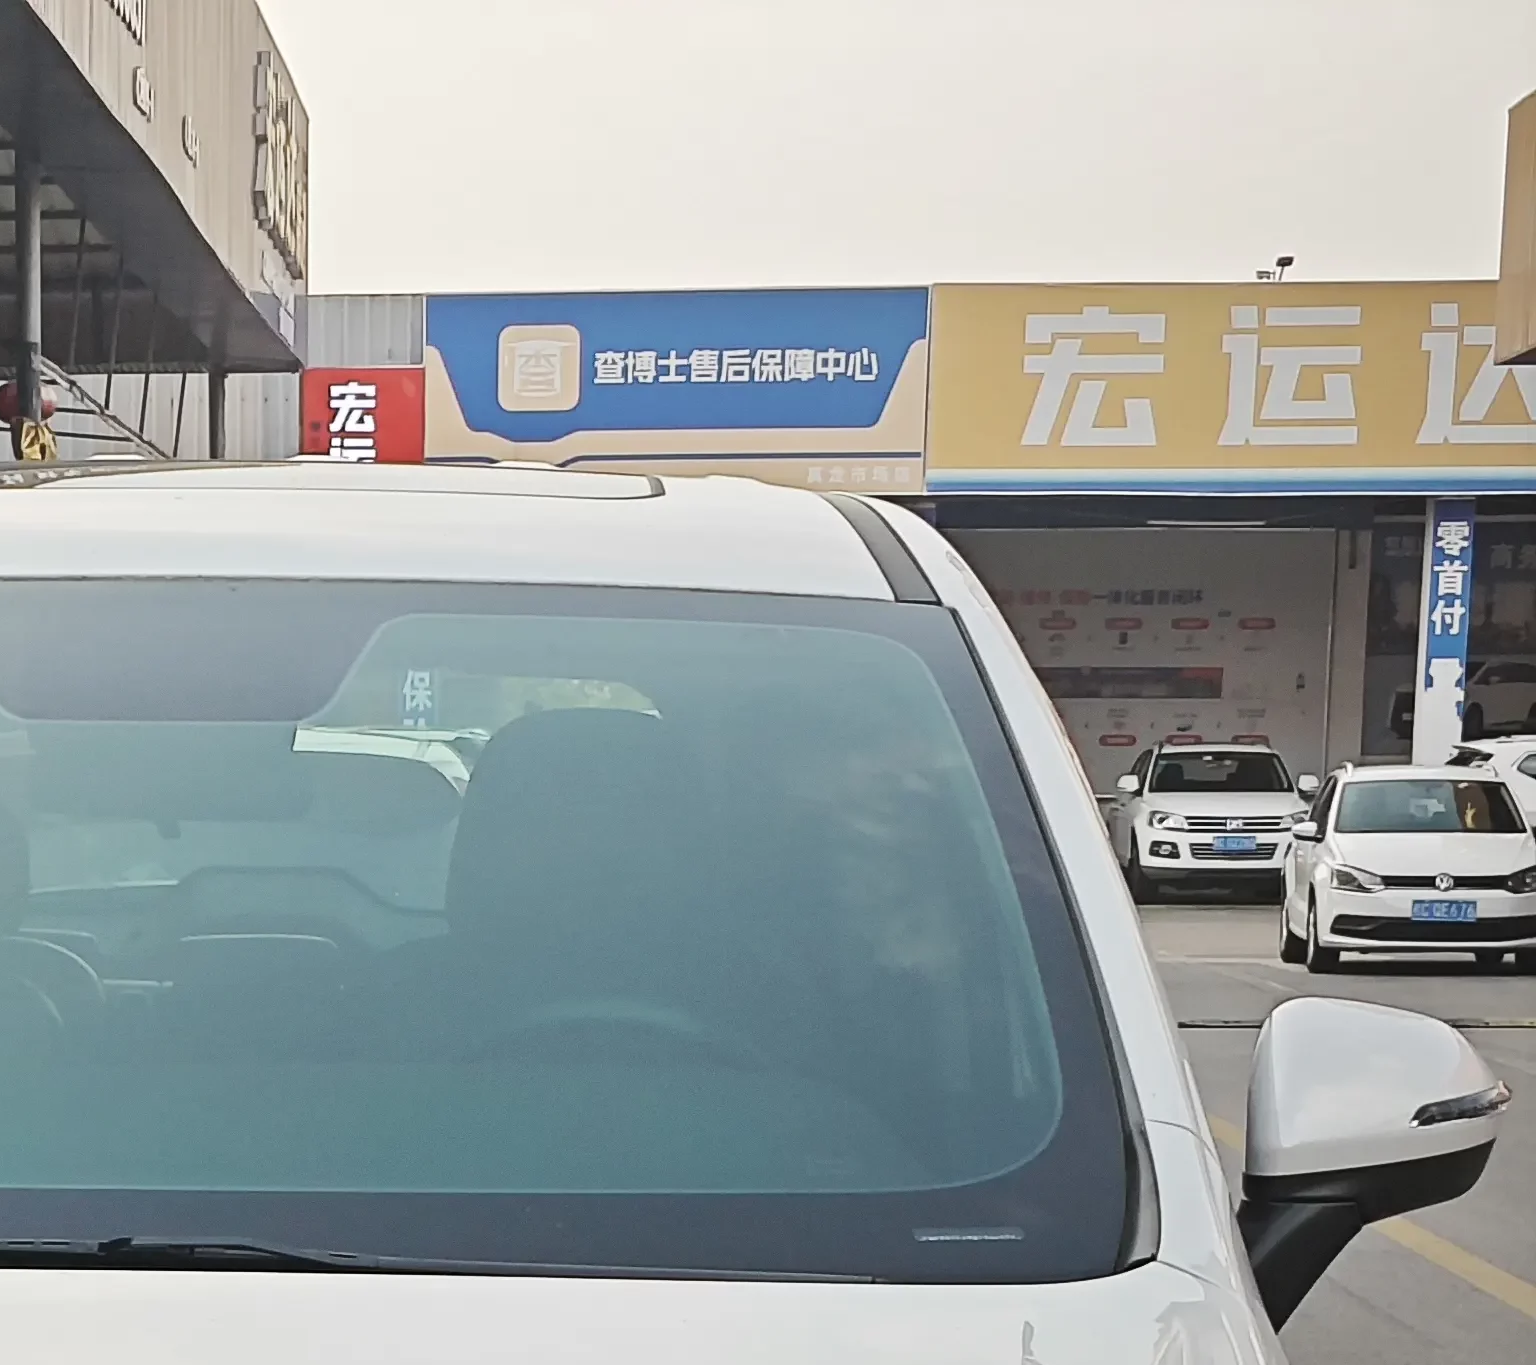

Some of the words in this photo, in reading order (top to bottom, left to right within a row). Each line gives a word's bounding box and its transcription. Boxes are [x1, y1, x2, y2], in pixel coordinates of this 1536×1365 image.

[594, 347, 879, 384] 查博士售后保障中心
[1430, 521, 1470, 635] 零首付
[403, 669, 432, 730] 保
